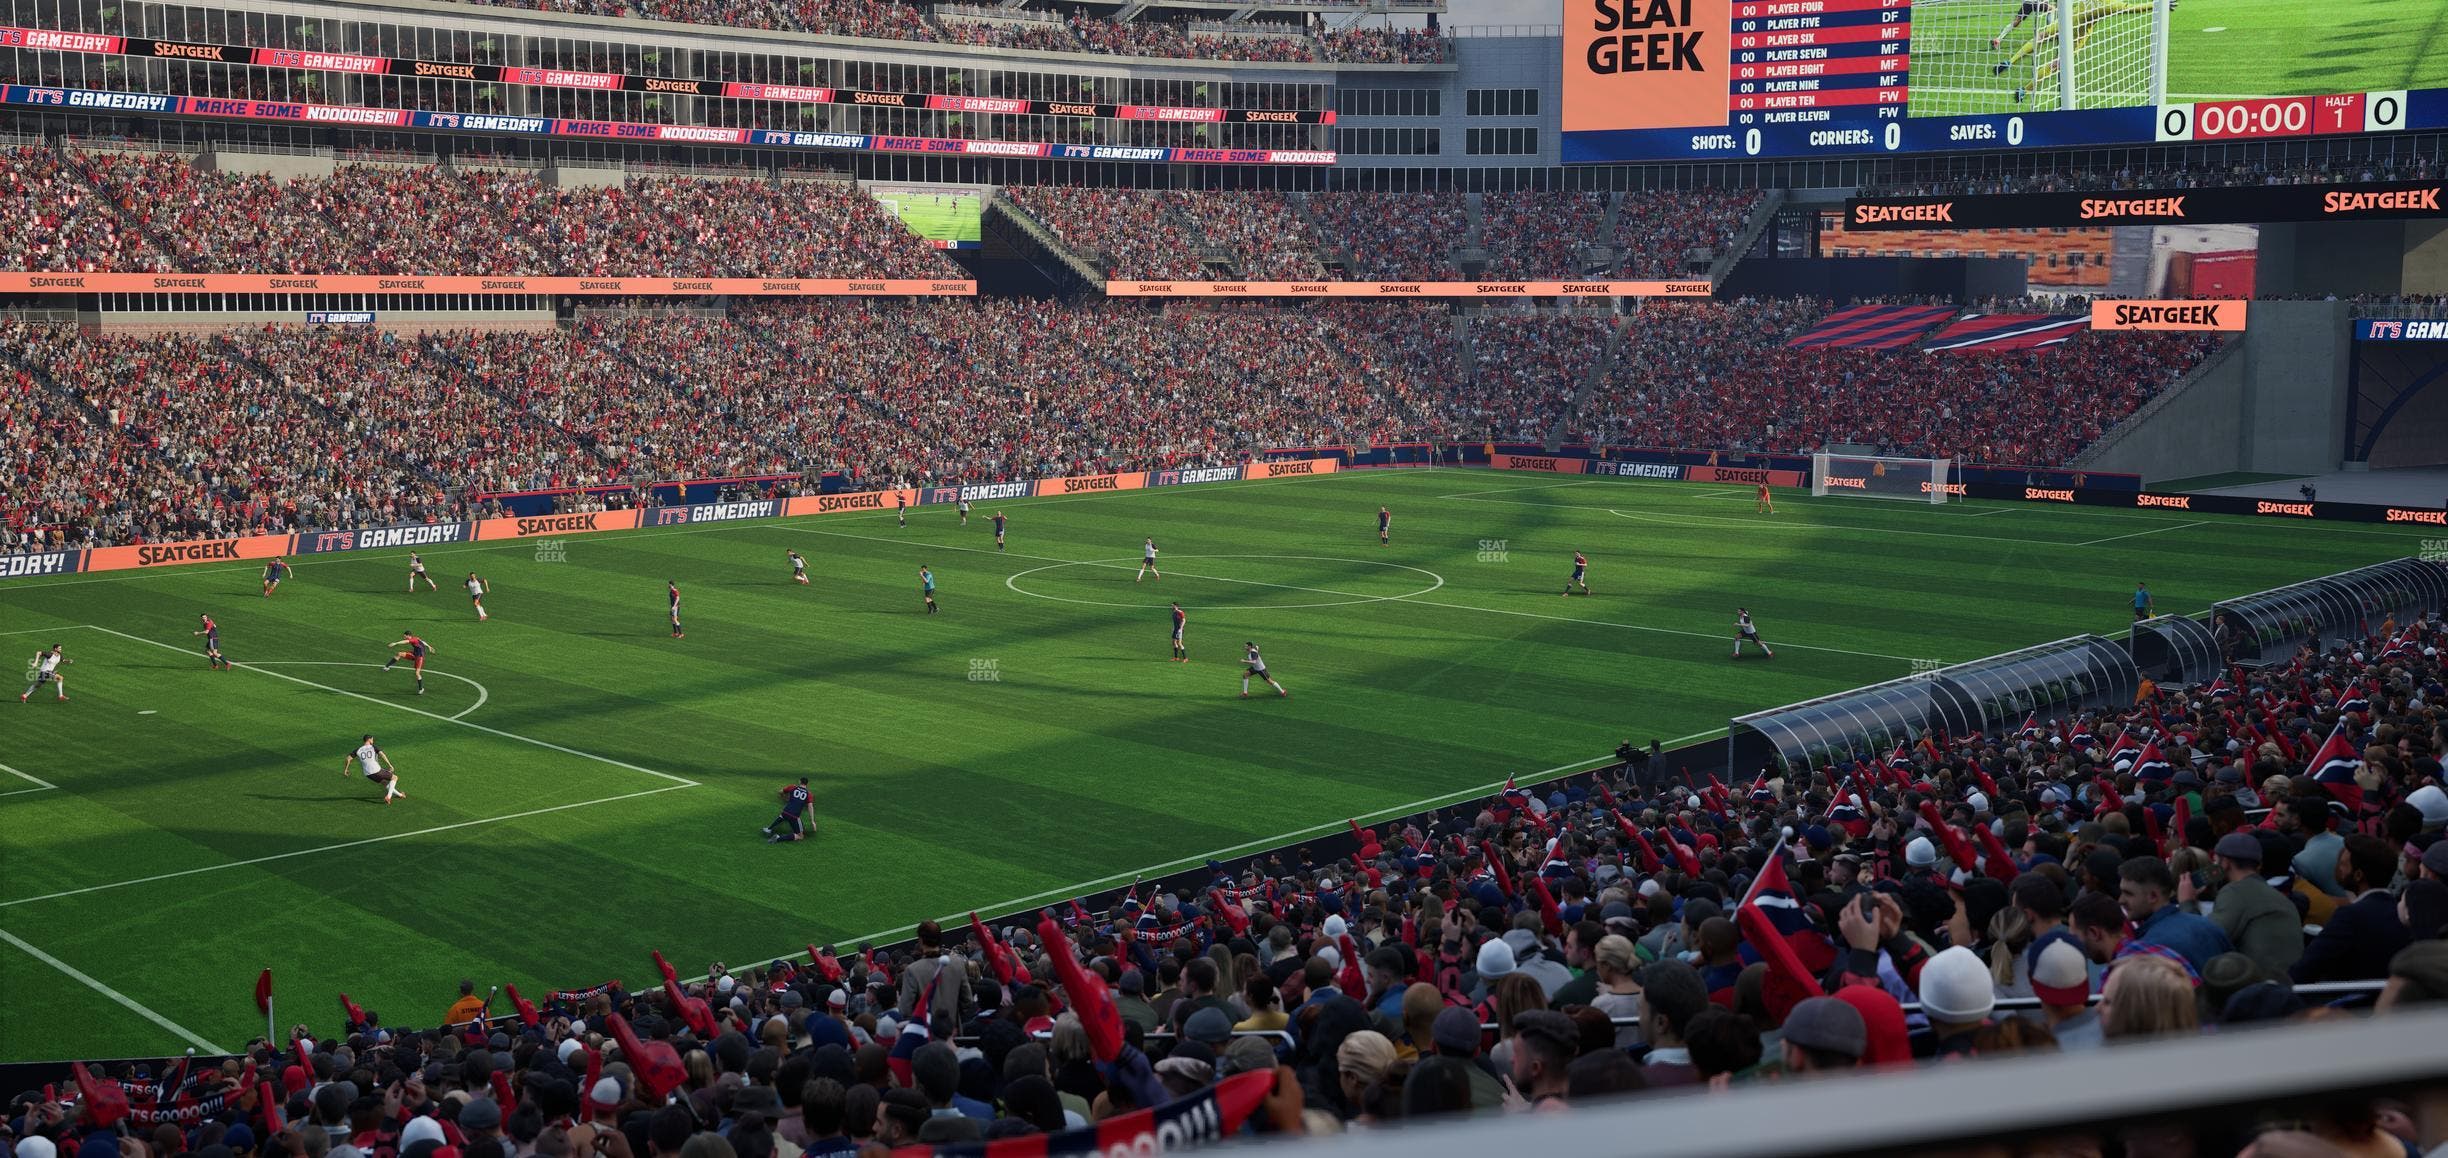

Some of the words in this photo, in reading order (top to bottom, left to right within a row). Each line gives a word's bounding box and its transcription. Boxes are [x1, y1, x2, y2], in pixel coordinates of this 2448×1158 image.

[1594, 0, 1692, 31] SEAT
[1742, 5, 1757, 16] 00
[1768, 2, 1800, 14] PLAYER
[1801, 1, 1824, 12] FOUR
[1742, 21, 1756, 32] 00
[1767, 18, 1799, 30] PLAYER
[1801, 17, 1820, 28] FIVE
[1882, 11, 1898, 23] DF
[27, 31, 110, 51] GAMEDAY!
[1742, 36, 1756, 47] 00
[1767, 34, 1799, 45] PLAYER
[1800, 33, 1815, 44] SIX
[1881, 27, 1899, 38] MF
[154, 42, 224, 61] SEATGEEK
[1587, 31, 1705, 75] GEEK
[1741, 52, 1755, 62] 00
[1766, 50, 1798, 61] PLAYER
[1800, 48, 1827, 60] SEVEN
[1881, 43, 1899, 55] MF
[273, 52, 300, 65] IT'S
[304, 54, 376, 71] GAMEDAY!
[1741, 67, 1755, 78] 00
[1766, 65, 1798, 76] PLAYER
[1799, 64, 1825, 74] EIGHT
[1880, 59, 1898, 71] MF
[415, 62, 476, 79] SEATGEEK
[519, 70, 542, 83] IT'S
[546, 72, 611, 88] GAMEDAY!
[645, 79, 700, 94] SEATGEEK
[1740, 83, 1754, 93] 00
[1765, 81, 1797, 92] PLAYER
[1799, 80, 1819, 90] NINE
[1880, 75, 1898, 87] MF
[27, 89, 65, 104] IT'S
[69, 92, 167, 111] GAMEDAY!
[739, 85, 761, 97] IT'S
[764, 87, 824, 101] GAMEDAY!
[854, 91, 905, 106] SEATGEEK
[1740, 98, 1754, 109] 00
[1765, 96, 1797, 107] PLAYER
[1799, 95, 1815, 106] TEN
[1879, 91, 1899, 103] FW
[2325, 96, 2354, 107] HALF
[195, 100, 247, 116] MAKE
[255, 103, 302, 118] SOME
[306, 106, 399, 124] NOOOOISE!!!
[941, 97, 961, 109] IT'S
[964, 99, 1019, 112] GAMEDAY!
[1049, 102, 1097, 116] SEATGEEK
[2374, 97, 2399, 125] 0
[1134, 107, 1156, 119] IT'S
[1158, 108, 1216, 121] GAMEDAY!
[1246, 111, 1299, 123] SEATGEEK
[1739, 113, 1753, 124] 00
[1764, 112, 1796, 123] PLAYER
[1798, 110, 1830, 121] ELEVEN
[1878, 107, 1898, 119] FW
[2164, 109, 2186, 136] 0
[2201, 102, 2307, 135] 00:00
[2333, 109, 2343, 128] 1
[429, 114, 460, 128] IT'S
[463, 115, 543, 133] GAMEDAY!
[566, 122, 611, 136] MAKE
[617, 124, 657, 138] SOME
[660, 127, 739, 142] NOOOOISE!!!
[1950, 123, 1997, 140] SAVES:
[2007, 117, 2023, 145] 0
[764, 132, 791, 146] IT'S
[794, 133, 864, 149] GAMEDAY!
[883, 138, 922, 151] MAKE
[928, 140, 964, 152] SOME
[1692, 135, 1737, 150] SHOTS:
[1745, 128, 1761, 155] 0
[1810, 129, 1874, 146] CORNERS:
[1884, 123, 1900, 150] 0
[1064, 145, 1091, 159] IT'S
[1093, 146, 1163, 161] GAMEDAY!
[1183, 150, 1223, 162] MAKE
[1229, 151, 1268, 163] SOME
[2080, 196, 2185, 219] SEATGEEK
[2324, 188, 2441, 213] SEATGEEK
[1855, 203, 1953, 224] SEATGEEK
[30, 277, 85, 288] SEATGEEK
[154, 278, 206, 288] SEATGEEK
[270, 279, 319, 289] SEATGEEK
[379, 280, 425, 290] SEATGEEK
[482, 281, 526, 290] SEATGEEK
[580, 281, 622, 291] SEATGEEK
[673, 282, 713, 291] SEATGEEK
[763, 282, 801, 292] SEATGEEK
[849, 283, 886, 292] SEATGEEK
[932, 284, 968, 292] SEATGEEK
[1138, 284, 1172, 293] SEATGEEK
[1213, 284, 1247, 293] SEATGEEK
[1290, 284, 1328, 293] SEATGEEK
[1380, 284, 1421, 294] SEATGEEK
[1476, 284, 1525, 294] SEATGEEK
[1562, 284, 1609, 294] SEATGEEK
[1665, 284, 1709, 294] SEATGEEK
[328, 313, 371, 322] GAMEDAY!
[2115, 305, 2220, 326] SEATGEEK
[2369, 321, 2403, 338] IT'S
[1268, 461, 1314, 477] SEATGEEK
[1510, 456, 1558, 472] SEATGEEK
[1595, 461, 1617, 475] IT'S
[1619, 463, 1679, 479] GAMEDAY!
[1065, 475, 1119, 493] SEATGEEK
[1158, 471, 1179, 485] IT'S
[1182, 467, 1237, 483] GAMEDAY!
[1714, 469, 1769, 484] SEATGEEK
[1823, 476, 1866, 489] SEATGEEK
[933, 486, 957, 504] IT'S
[961, 482, 1028, 501] GAMEDAY!
[1921, 481, 1967, 495] SEATGEEK
[2025, 487, 2074, 502] SEATGEEK
[819, 492, 884, 513] SEATGEEK
[2137, 494, 2190, 508] SEATGEEK
[2257, 501, 2314, 517] SEATGEEK
[658, 508, 688, 525] IT'S
[693, 501, 773, 522] GAMEDAY!
[2386, 508, 2447, 525] SEATGEEK
[517, 513, 597, 536] SEATGEEK
[316, 532, 354, 552] IT'S
[360, 524, 460, 548] GAMEDAY!
[139, 540, 240, 566] SEATGEEK
[361, 751, 372, 760] 00
[793, 789, 807, 801] 00
